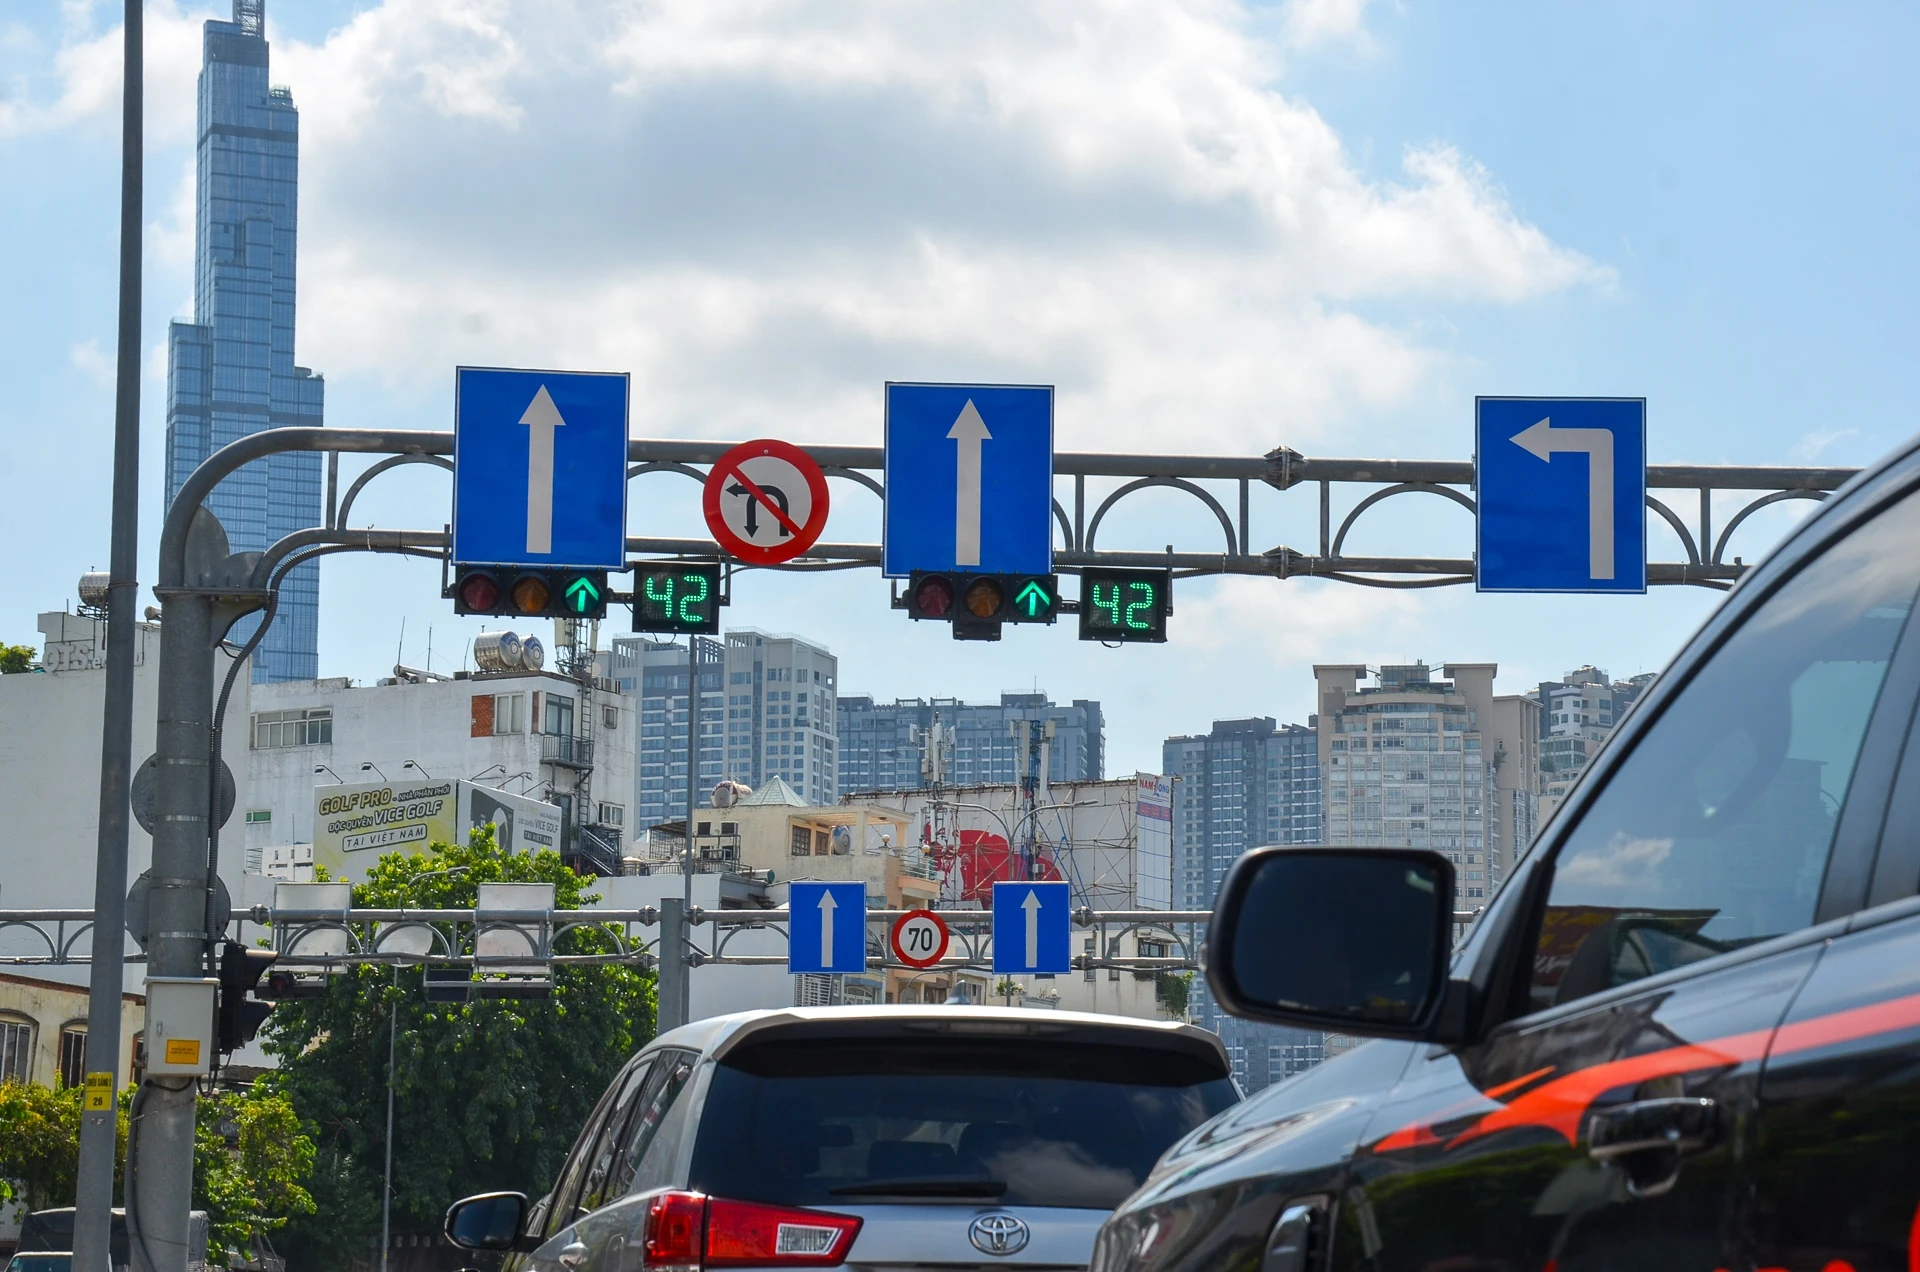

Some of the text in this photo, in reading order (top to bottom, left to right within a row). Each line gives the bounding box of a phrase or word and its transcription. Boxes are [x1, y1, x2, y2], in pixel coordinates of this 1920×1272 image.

[646, 575, 707, 621] 42
[1093, 583, 1153, 629] 42
[319, 793, 359, 815] GOLF
[360, 788, 392, 809] PRO
[328, 820, 348, 834] ĐỘC
[374, 806, 405, 825] VICE
[407, 800, 443, 819] GOLF
[534, 819, 546, 831] VICE
[546, 822, 559, 833] GOLF
[347, 827, 424, 848] TẠI VIỆT NAM
[908, 927, 933, 952] 70
[93, 1096, 103, 1106] 26
